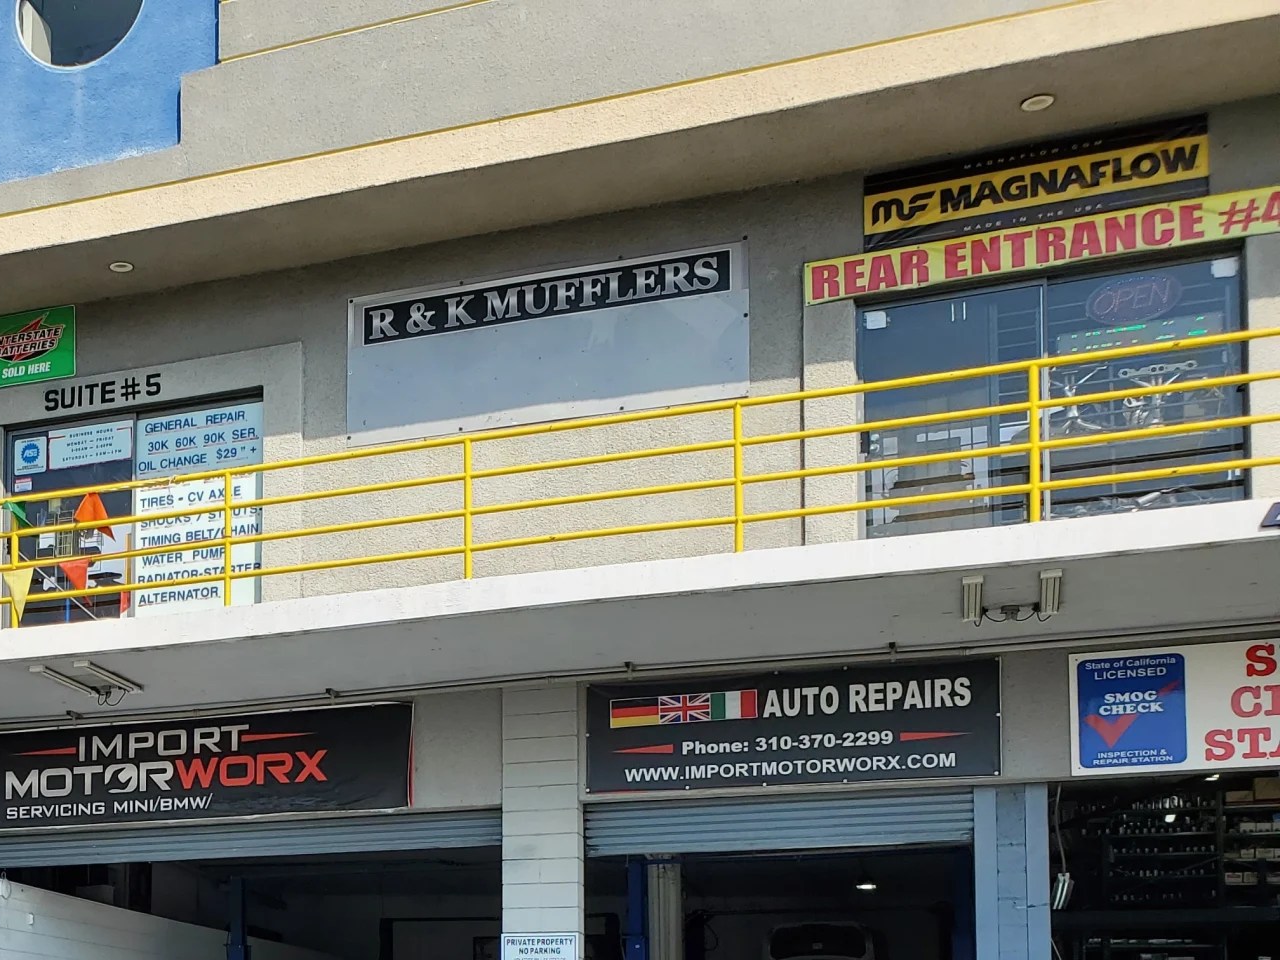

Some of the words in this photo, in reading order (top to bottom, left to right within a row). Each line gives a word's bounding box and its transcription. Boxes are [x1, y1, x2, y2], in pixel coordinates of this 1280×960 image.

[940, 144, 1200, 214] MAGNAFLOW
[963, 220, 1002, 233] MADE
[1012, 215, 1027, 224] IN
[1037, 209, 1064, 220] THE
[1074, 203, 1103, 213] USA
[812, 249, 929, 301] REAR
[945, 203, 1205, 280] ENTRANCE
[368, 308, 399, 340] R
[406, 303, 436, 334] &
[444, 294, 476, 328] K
[483, 256, 720, 322] MUFFLERS
[1092, 280, 1170, 318] OPEN
[1, 365, 25, 379] SOLD
[27, 361, 52, 374] HERE
[44, 380, 116, 412] SUITE
[145, 417, 197, 434] GENERAL
[206, 410, 245, 425] REPAIR
[148, 440, 169, 452] 30K
[175, 436, 196, 448] 60K
[203, 432, 225, 444] 90K
[138, 461, 156, 472] OIL
[160, 453, 207, 469] CHANGE
[140, 494, 174, 508] TIRES
[188, 491, 204, 503] CV
[208, 486, 242, 501] AXE
[141, 533, 181, 547] TIMING
[142, 552, 183, 566] WATER
[139, 586, 219, 605] ALTERNATOR
[1085, 662, 1110, 670] State
[1114, 660, 1123, 668] of
[1126, 657, 1176, 667] California
[1094, 667, 1167, 680] LICENSED
[763, 685, 839, 718] AUTO
[849, 677, 972, 713] REPAIRS
[1104, 690, 1158, 704] SMOG
[1099, 702, 1164, 715] CHECK
[79, 724, 250, 762] IMPORT
[682, 737, 749, 755] Phone:
[755, 729, 893, 751] 310-370-2299
[1093, 757, 1129, 765] REPAIR
[1131, 755, 1173, 763] STATION
[1097, 749, 1157, 758] INSPECTION
[5, 749, 328, 800] MOTORWORX
[625, 752, 956, 783] WWW.IMPORTMOTORWORX.COM
[6, 802, 106, 820] SERVICING
[506, 938, 535, 946] PRIVATE
[537, 938, 573, 946] PROPERTY
[519, 947, 529, 955] NO
[530, 947, 561, 955] PARKING
